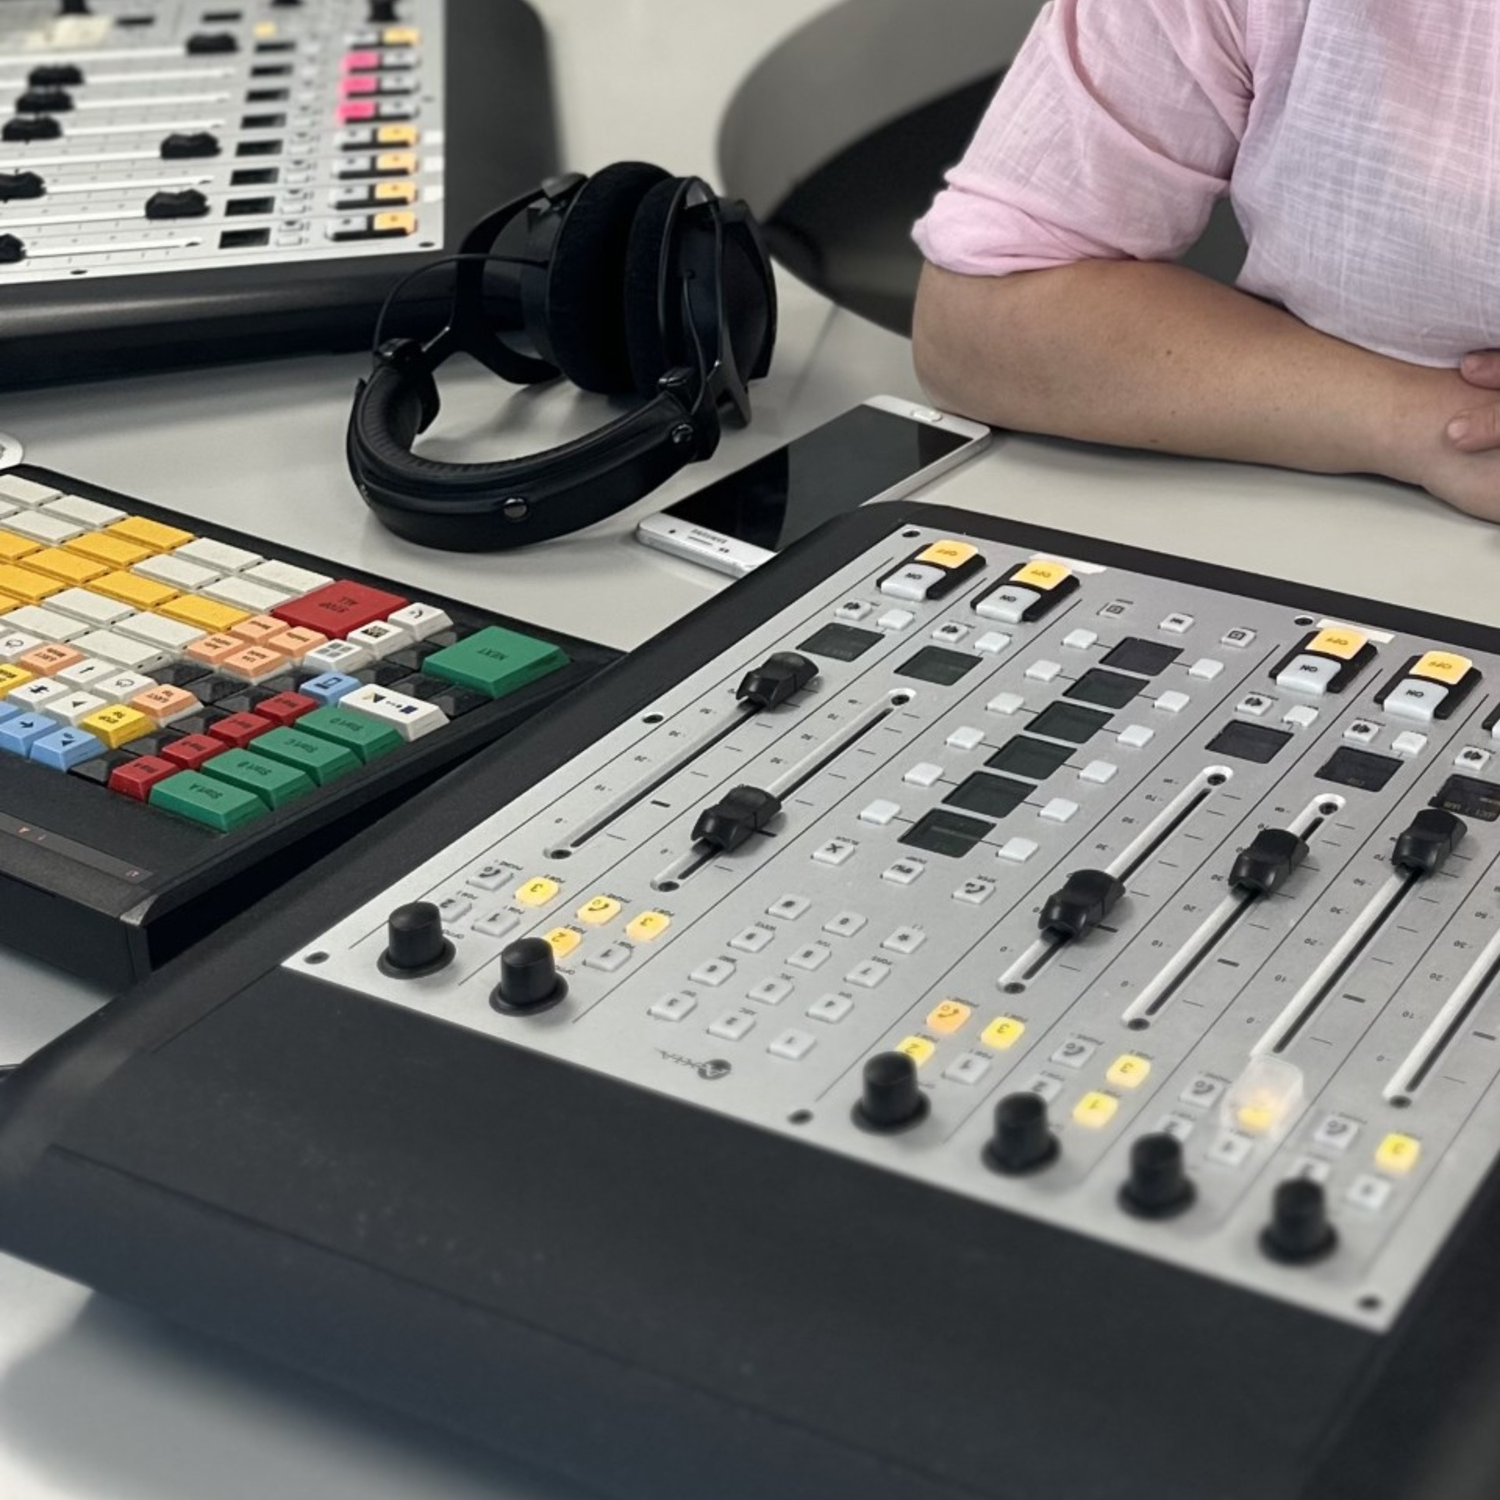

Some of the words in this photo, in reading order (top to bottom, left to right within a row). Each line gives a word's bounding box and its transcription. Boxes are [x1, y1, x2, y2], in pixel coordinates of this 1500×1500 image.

[904, 572, 922, 581] ON
[999, 594, 1017, 603] ON
[477, 647, 509, 661] NEXT
[1299, 664, 1318, 674] ON
[1405, 689, 1424, 699] ON
[341, 720, 364, 732] Start
[296, 742, 318, 754] Start
[250, 764, 272, 777] Start
[200, 787, 223, 800] Start
